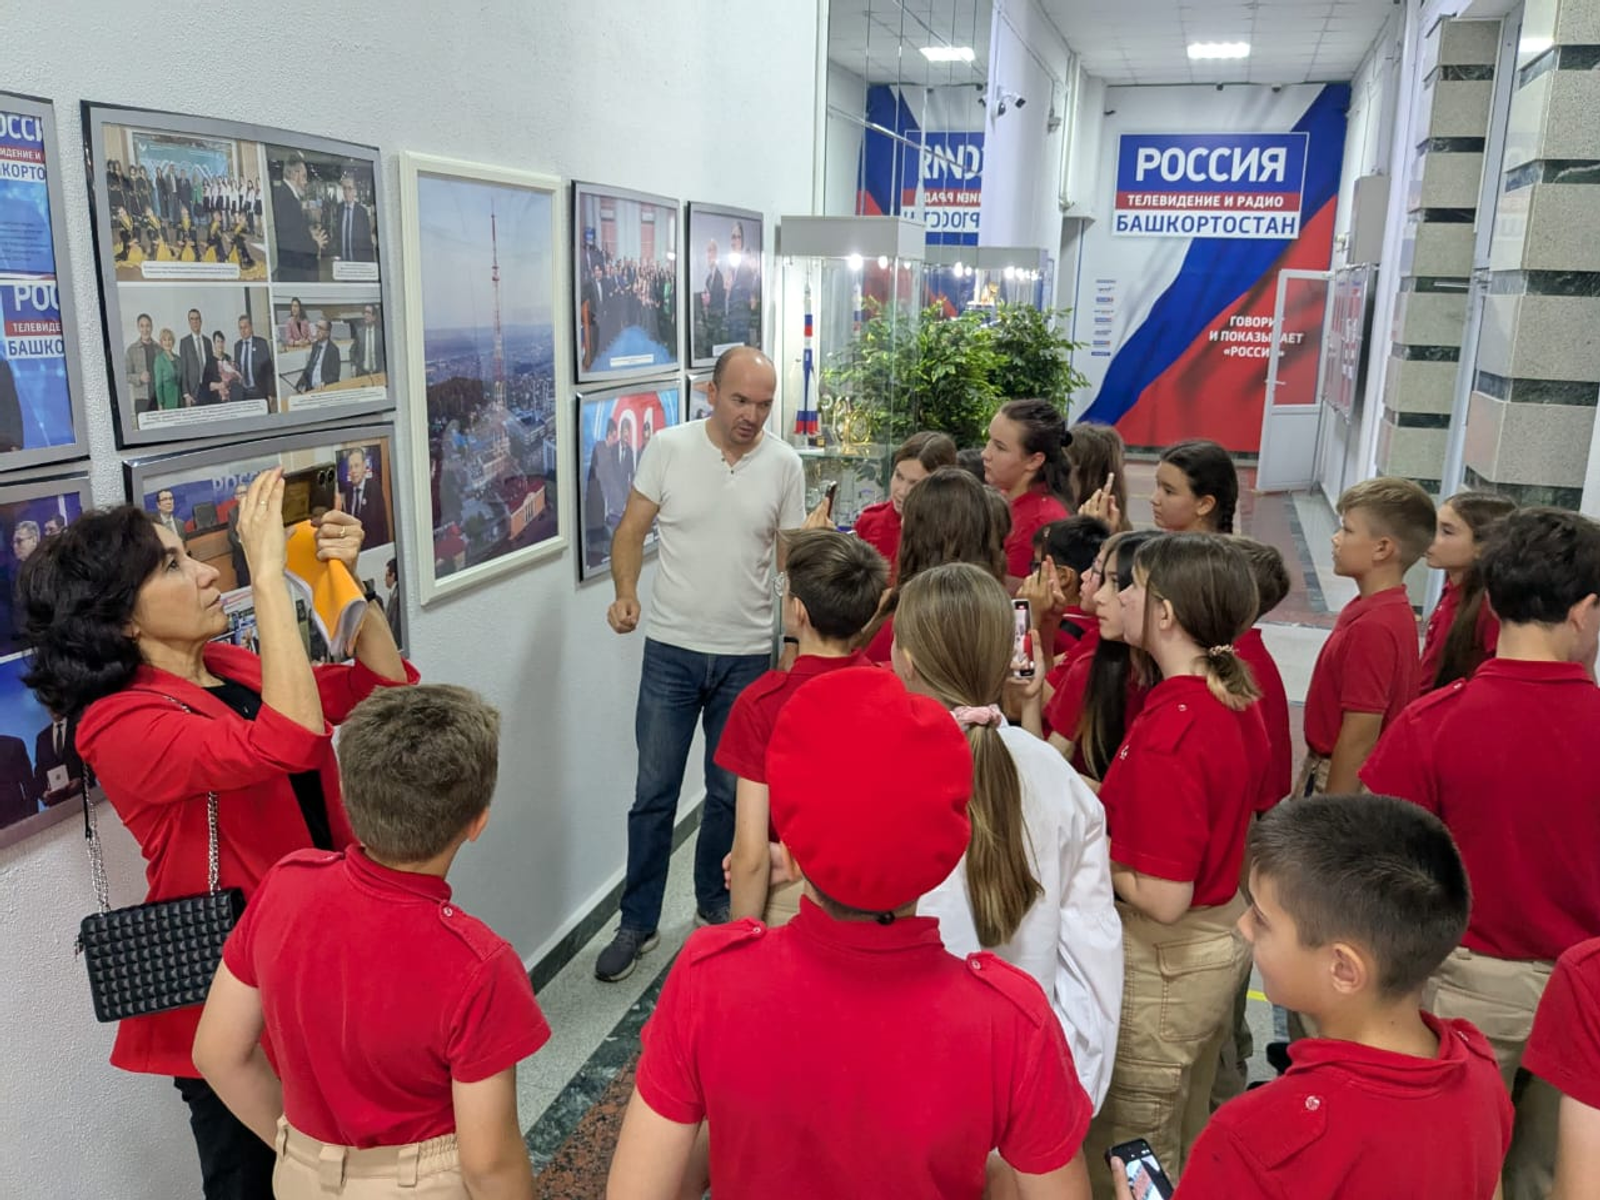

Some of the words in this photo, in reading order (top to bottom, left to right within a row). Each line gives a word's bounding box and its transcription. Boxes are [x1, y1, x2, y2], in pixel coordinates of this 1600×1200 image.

[1136, 146, 1287, 182] РОССИЯ
[1128, 194, 1220, 208] ТЕЛЕВИДЕНИЕ
[1224, 196, 1233, 207] И
[1237, 196, 1284, 209] РАДИО
[1116, 215, 1296, 235] БАШКОРТОСТАН
[1209, 330, 1218, 341] И
[1220, 331, 1304, 344] ПОКАЗЫАЕТ
[1223, 346, 1285, 358] «РОССИ»
